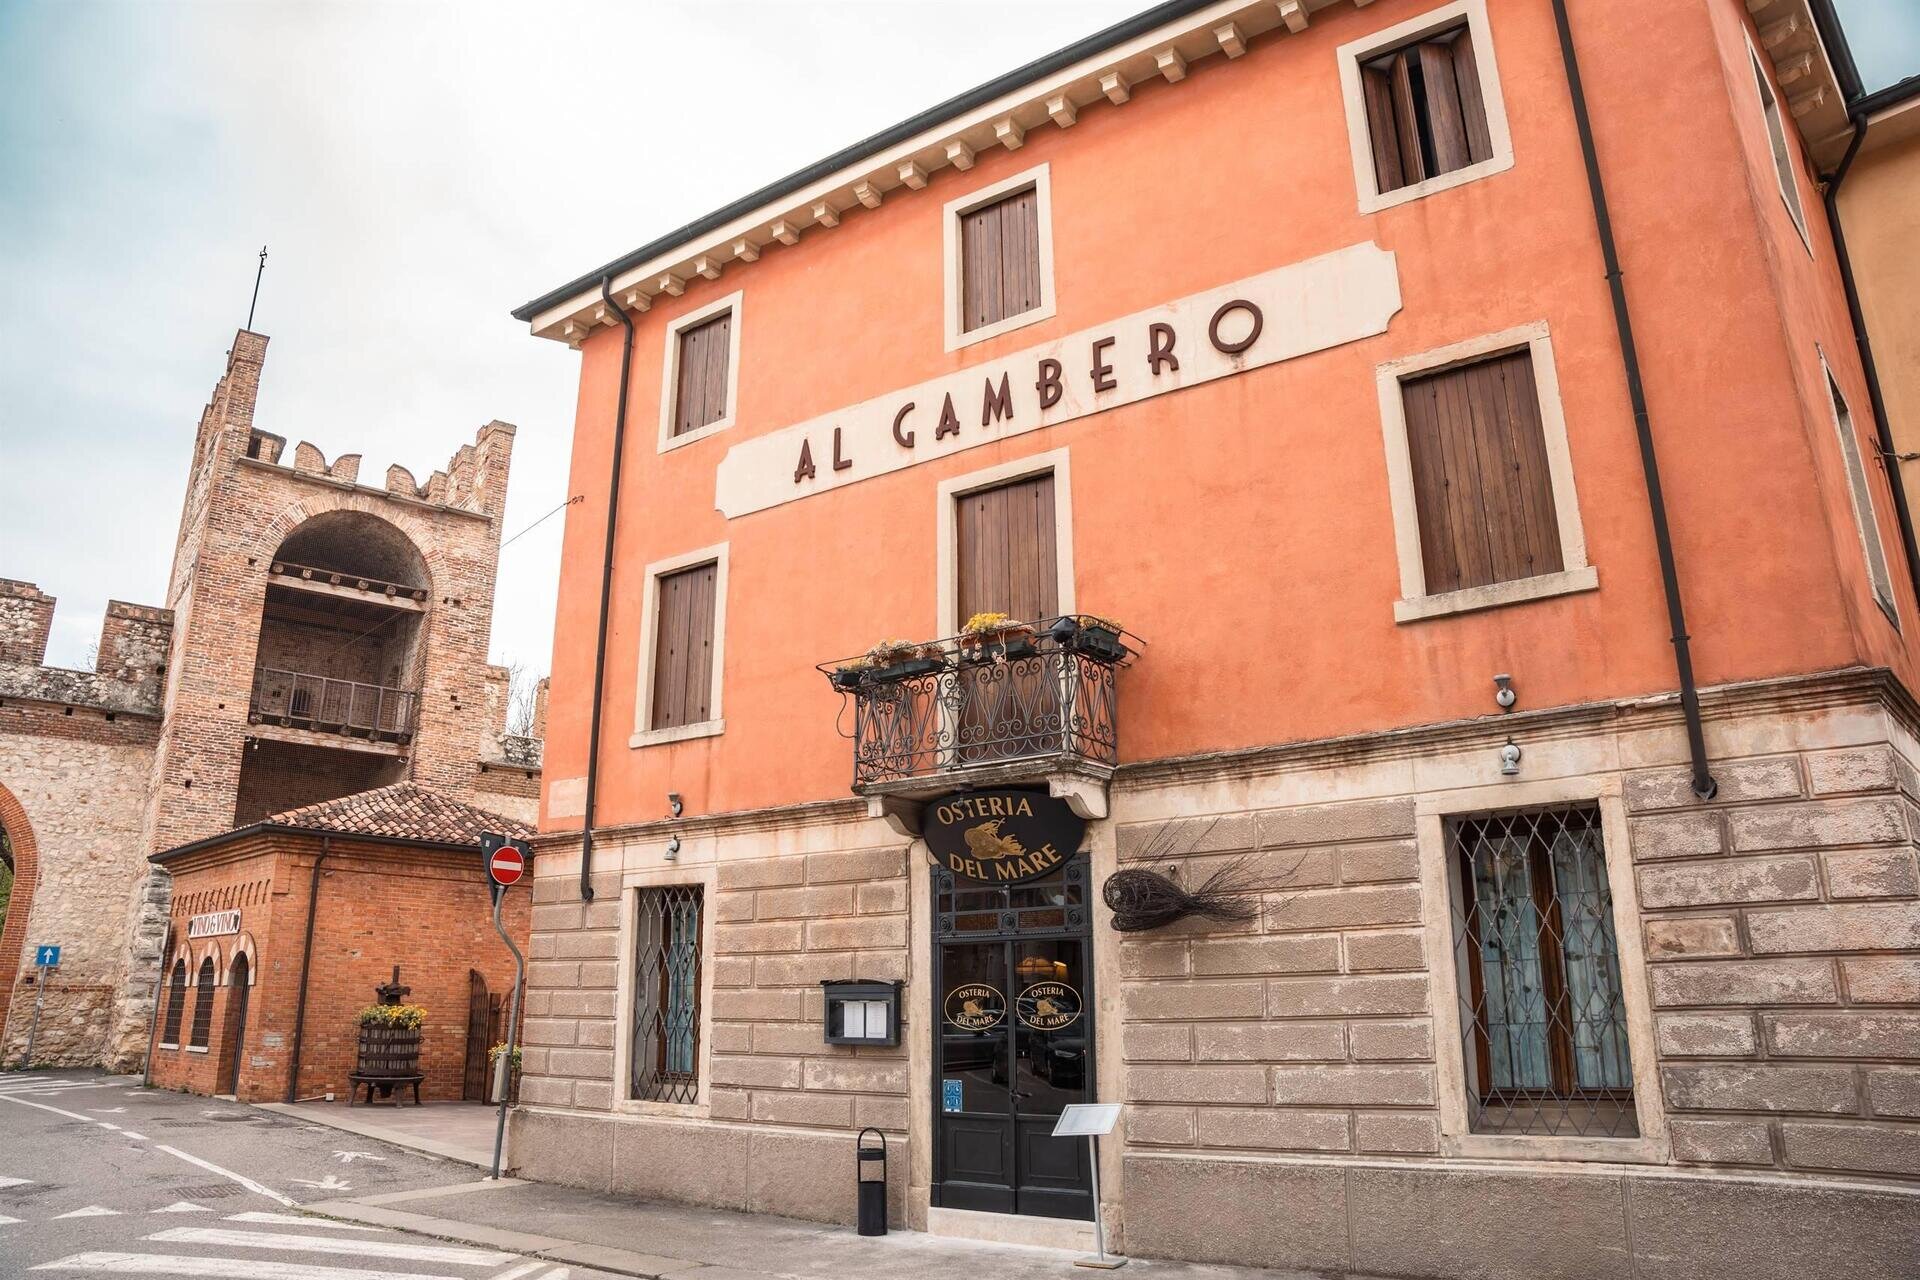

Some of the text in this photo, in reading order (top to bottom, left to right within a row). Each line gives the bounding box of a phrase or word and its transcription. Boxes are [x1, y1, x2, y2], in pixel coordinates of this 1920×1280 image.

[794, 298, 1263, 484] AL GAMBERO
[936, 796, 1034, 825] OSTERIA
[949, 843, 1063, 881] DEL MARE
[958, 988, 990, 999] OSTERIA
[1031, 986, 1064, 998] OSTERIA
[956, 1014, 995, 1026] DEL MARE
[1029, 1014, 1070, 1027] DEL MARE
